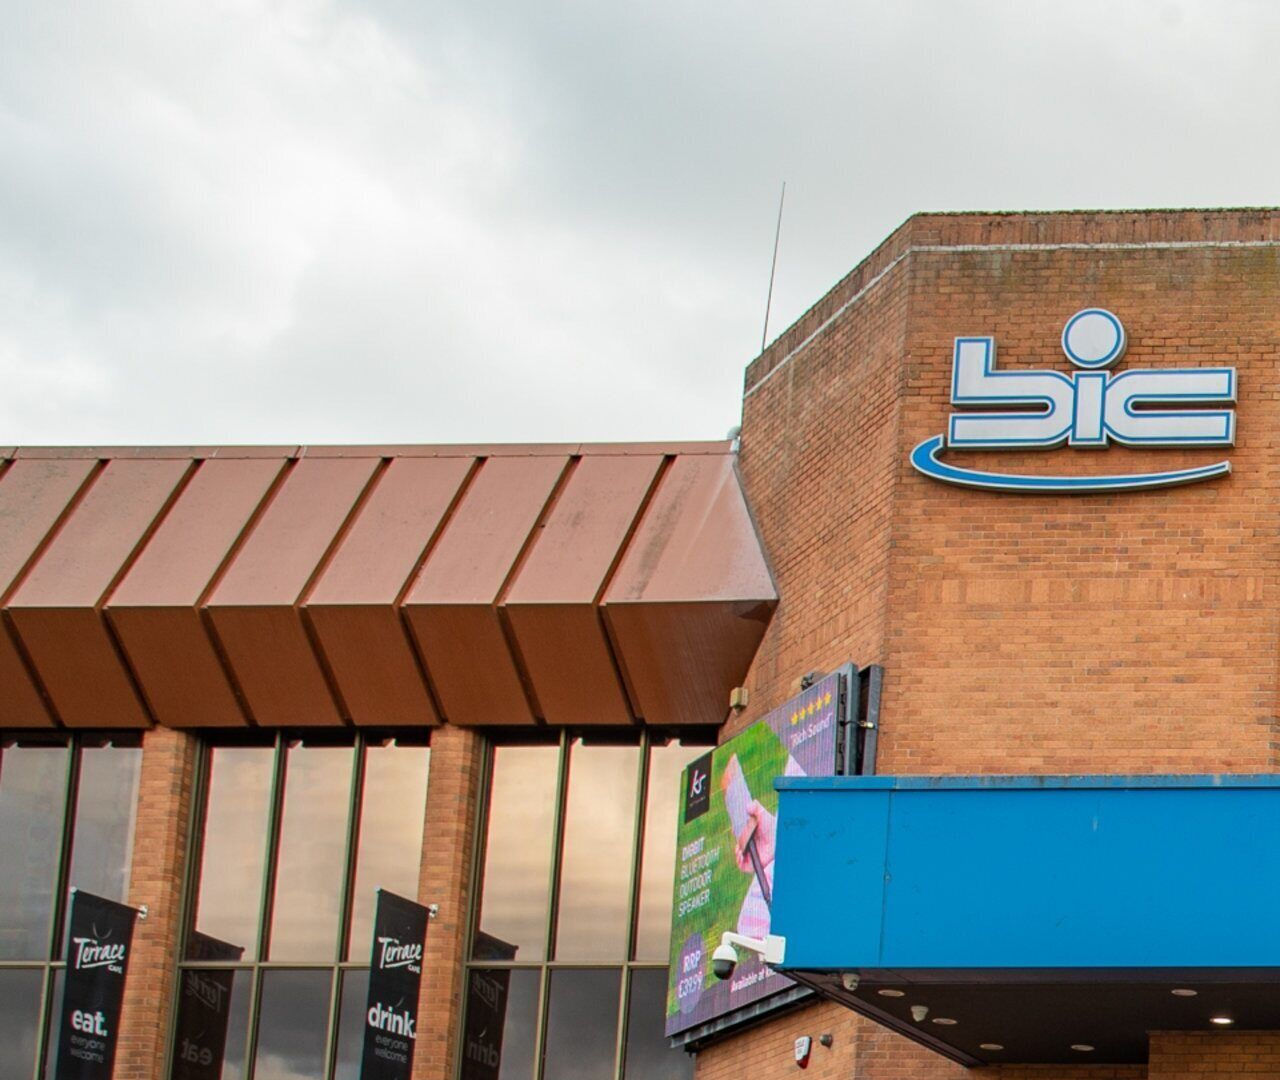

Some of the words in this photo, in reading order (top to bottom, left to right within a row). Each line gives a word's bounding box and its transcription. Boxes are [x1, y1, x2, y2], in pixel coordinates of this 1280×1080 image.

[948, 308, 1237, 447] bic
[678, 888, 710, 917] SPEAKER
[73, 937, 126, 969] Terrace
[378, 937, 422, 969] Terrace
[683, 950, 701, 973] RRP
[71, 1009, 107, 1037] eat.
[368, 1002, 417, 1038] drink.
